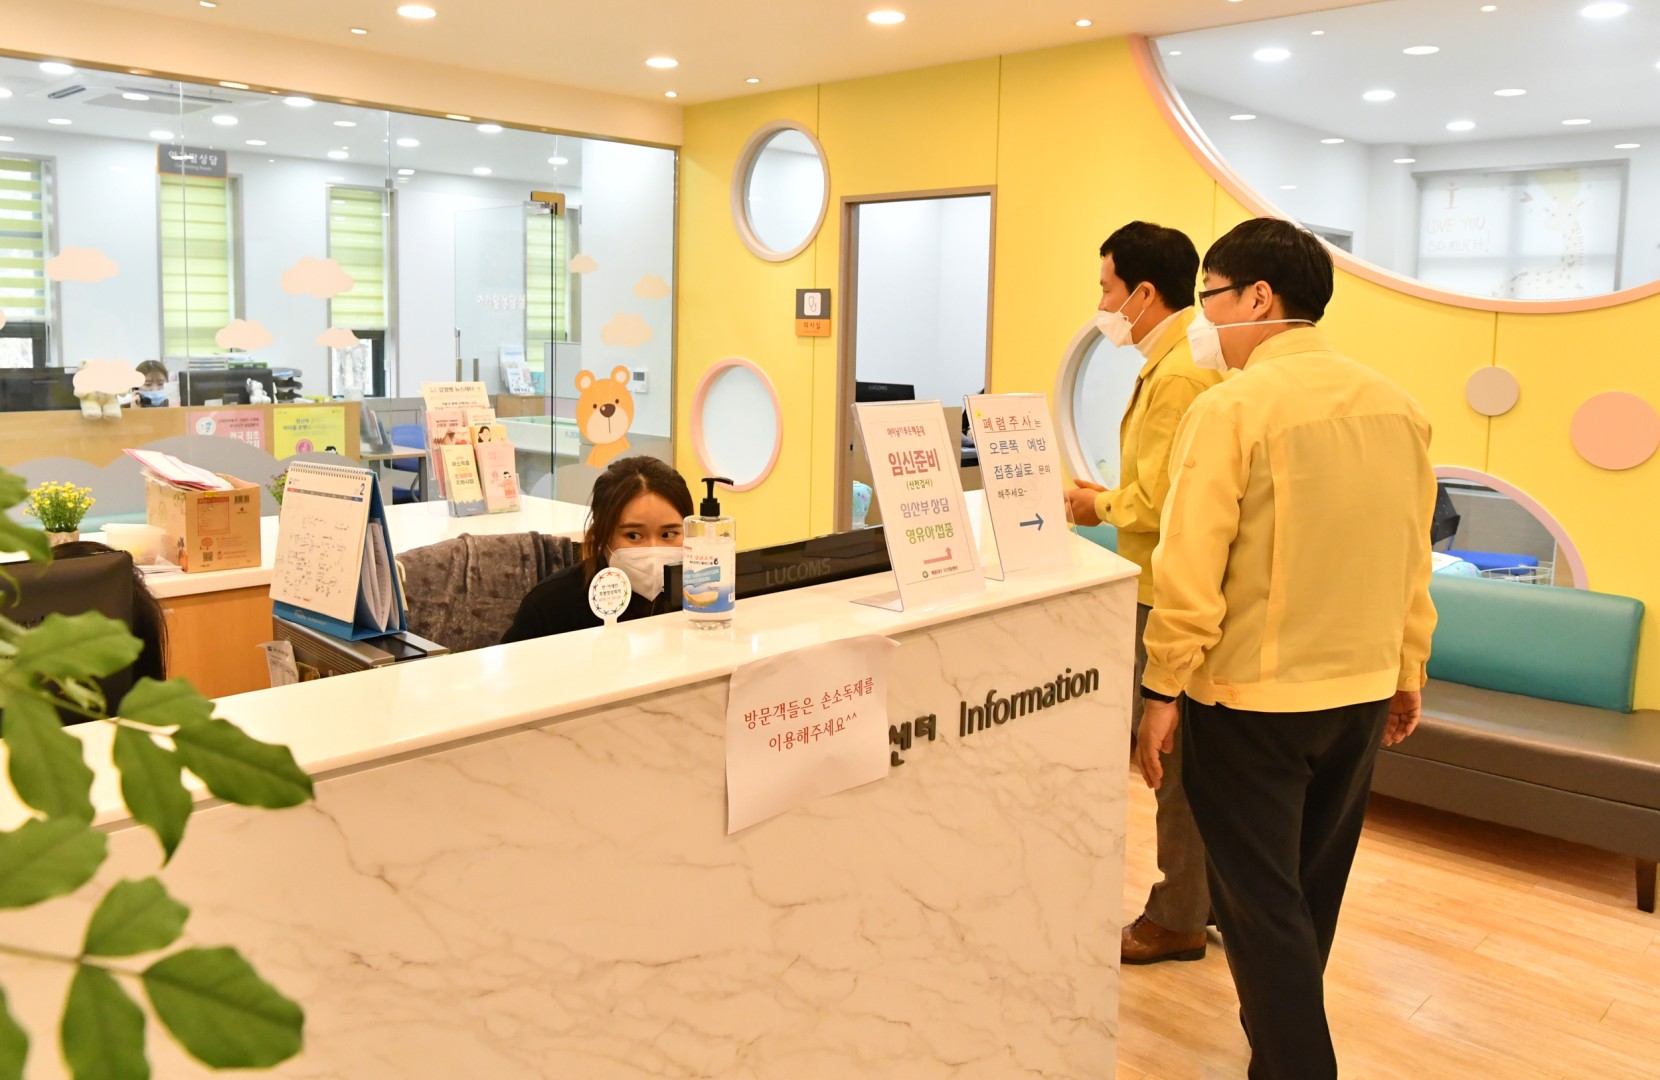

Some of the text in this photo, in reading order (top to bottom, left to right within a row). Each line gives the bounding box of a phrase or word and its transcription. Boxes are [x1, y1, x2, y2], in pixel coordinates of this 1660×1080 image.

[1426, 217, 1486, 234] LOVE YOU
[1427, 239, 1444, 253] SO
[989, 437, 1046, 455] 오른쪽 예방
[888, 447, 941, 476] 임신준비
[993, 462, 1051, 480] 접종실로 문의
[906, 478, 933, 491] (산전검사)
[900, 497, 950, 519] 임산부 상담
[766, 557, 832, 587] LUCOMS
[743, 676, 875, 731] 방문객들은 손소독제를
[959, 666, 1100, 738] Information
